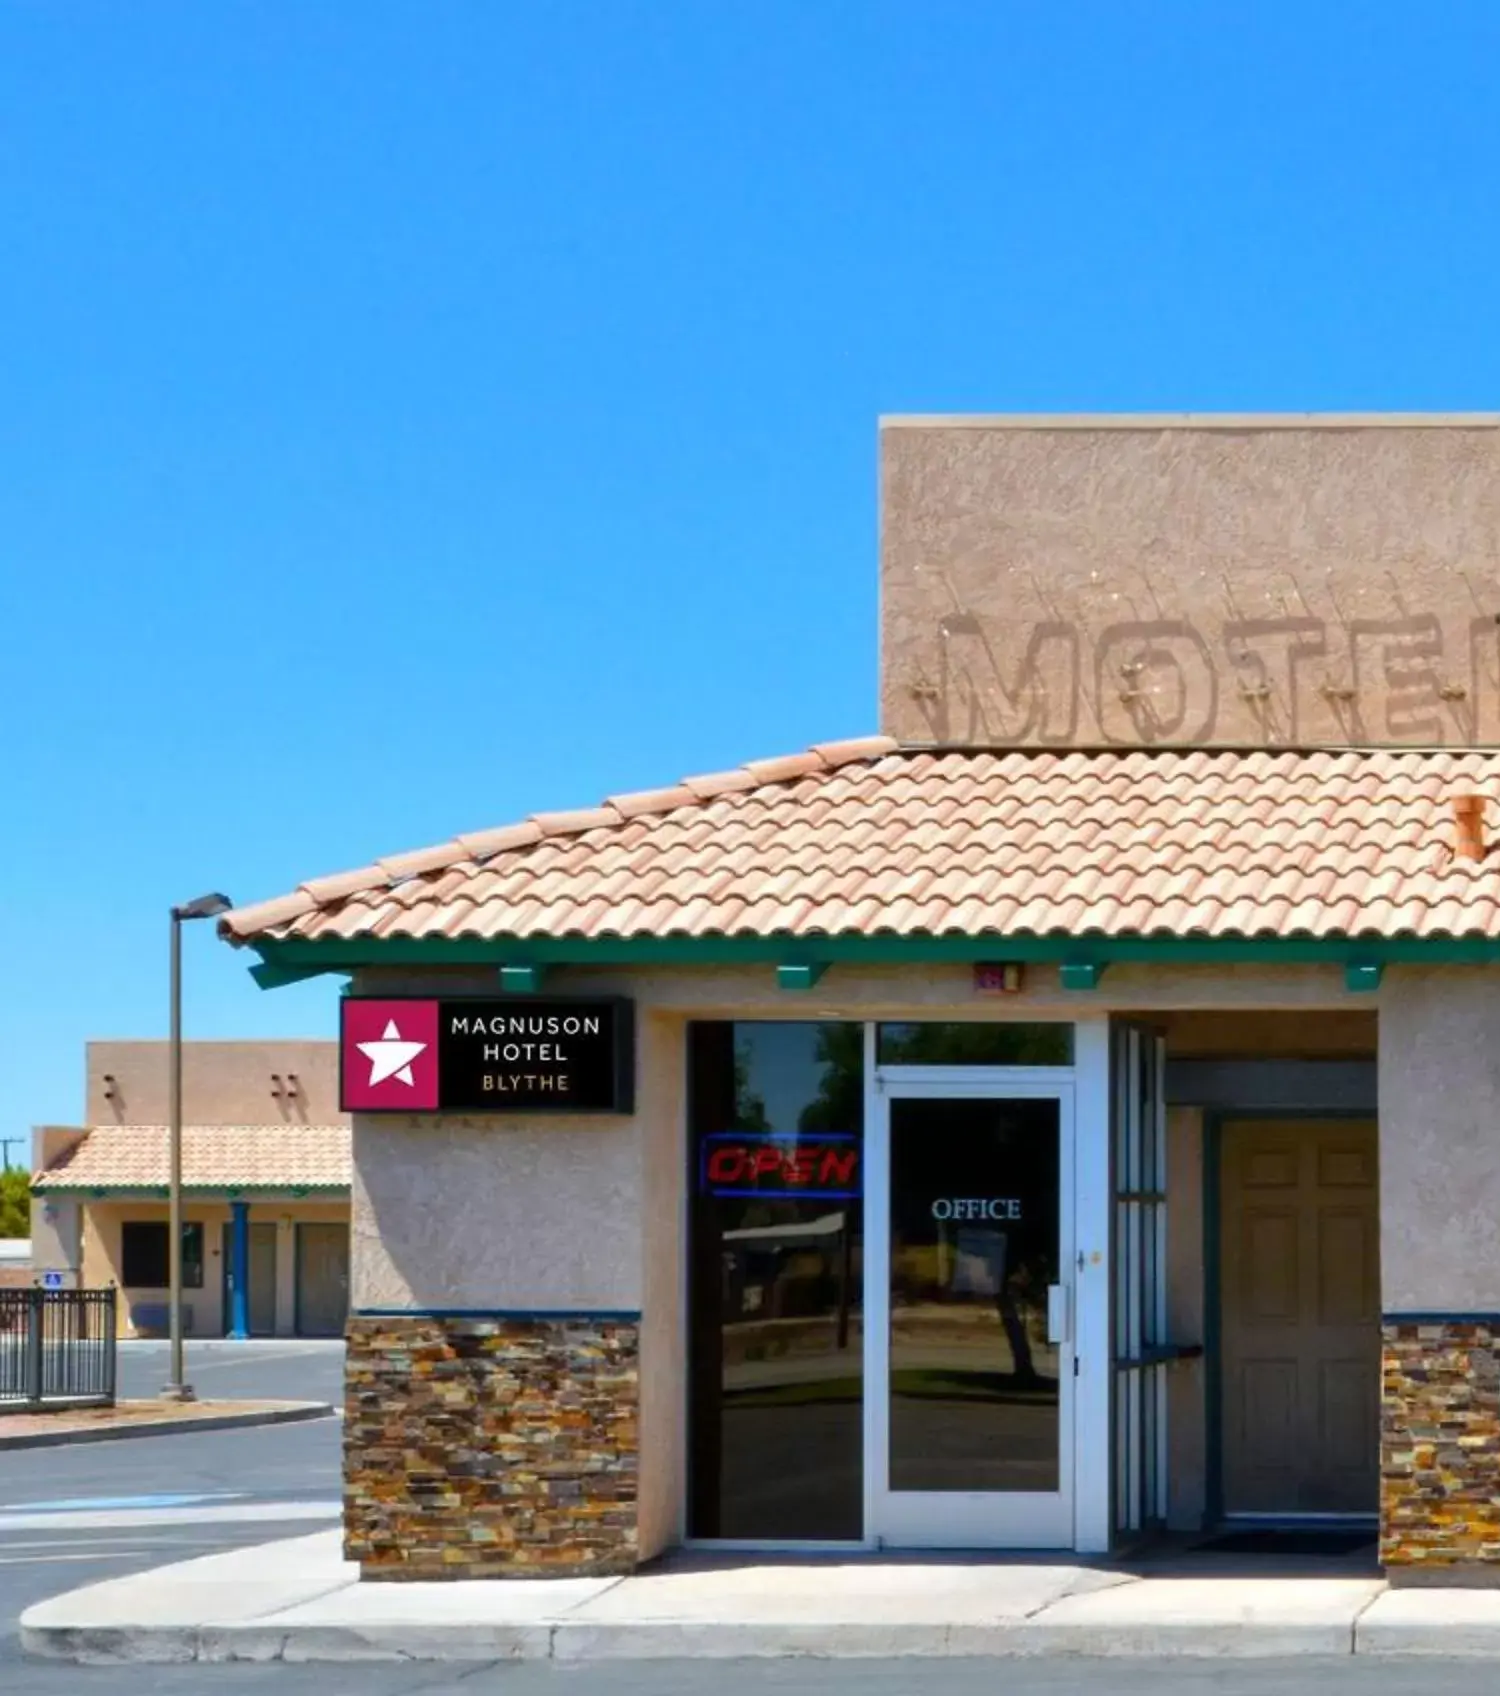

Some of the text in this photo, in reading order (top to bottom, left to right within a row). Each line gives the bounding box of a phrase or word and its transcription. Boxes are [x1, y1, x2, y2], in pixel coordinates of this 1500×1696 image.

[451, 1017, 600, 1035] MAGNUSON
[483, 1043, 568, 1061] HOTEL
[482, 1075, 569, 1091] BLYTHE
[708, 1146, 857, 1183] OPEN
[931, 1199, 1021, 1219] OFFICE
